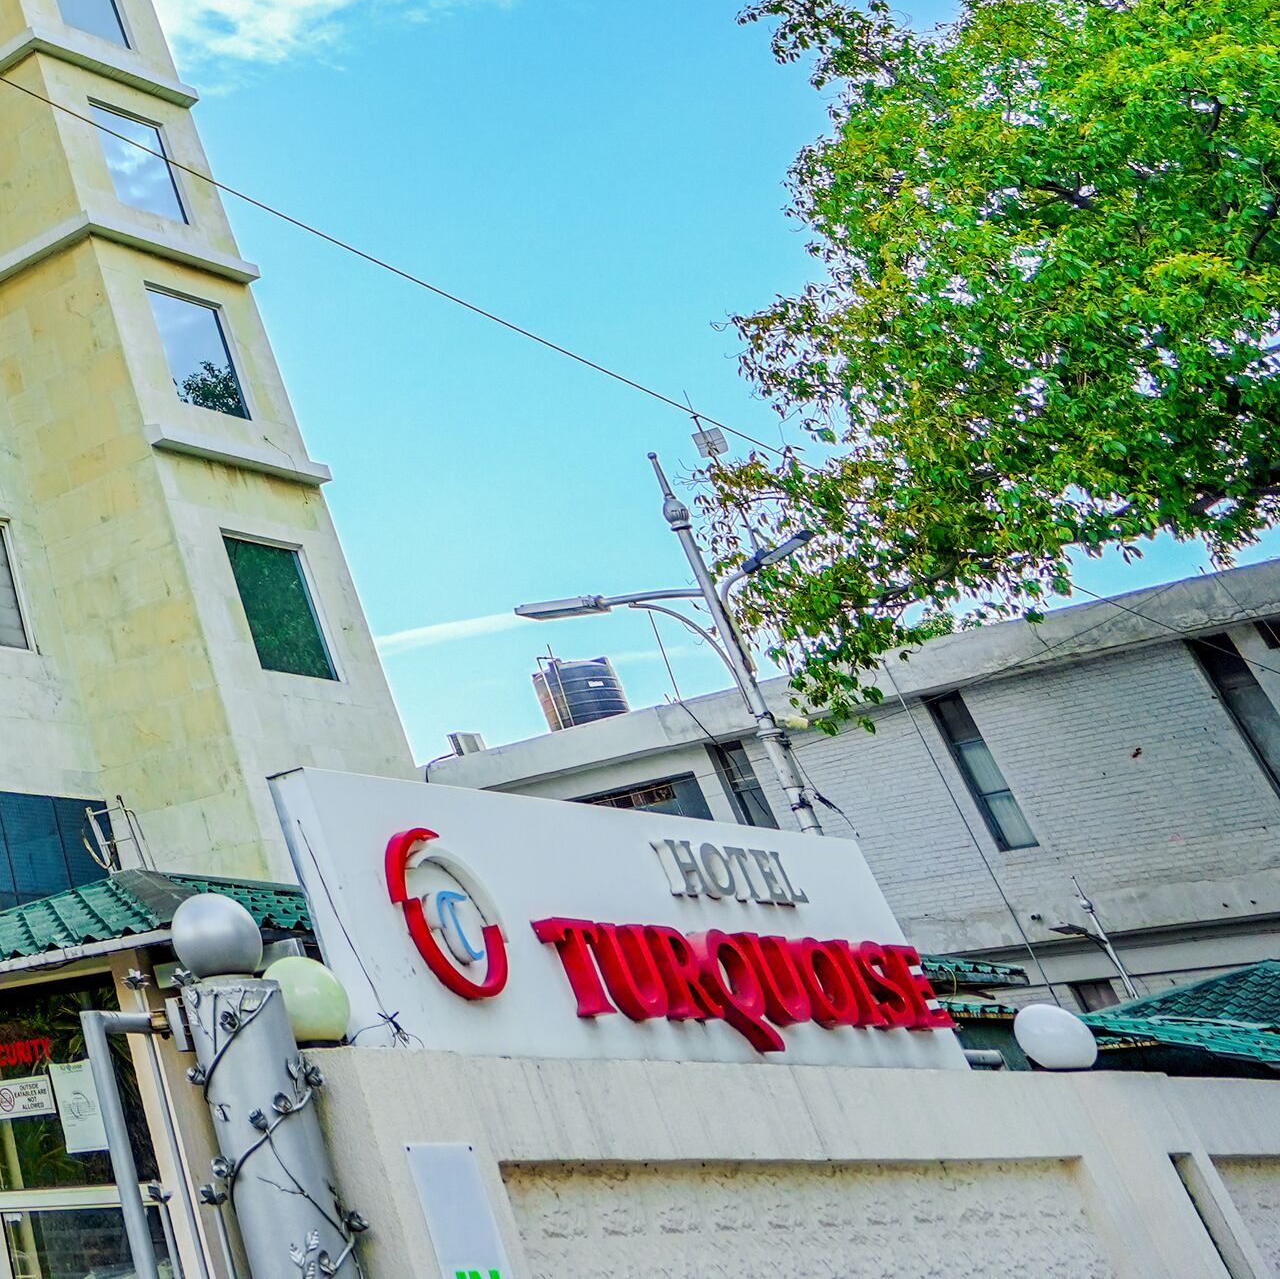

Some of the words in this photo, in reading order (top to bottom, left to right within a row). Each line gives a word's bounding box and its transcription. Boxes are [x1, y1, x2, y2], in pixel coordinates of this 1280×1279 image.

[651, 838, 810, 906] HOTEL
[532, 916, 956, 1052] TURQUOISE
[19, 1083, 39, 1091] OUTSIDE
[22, 1102, 45, 1110] ALLOWED
